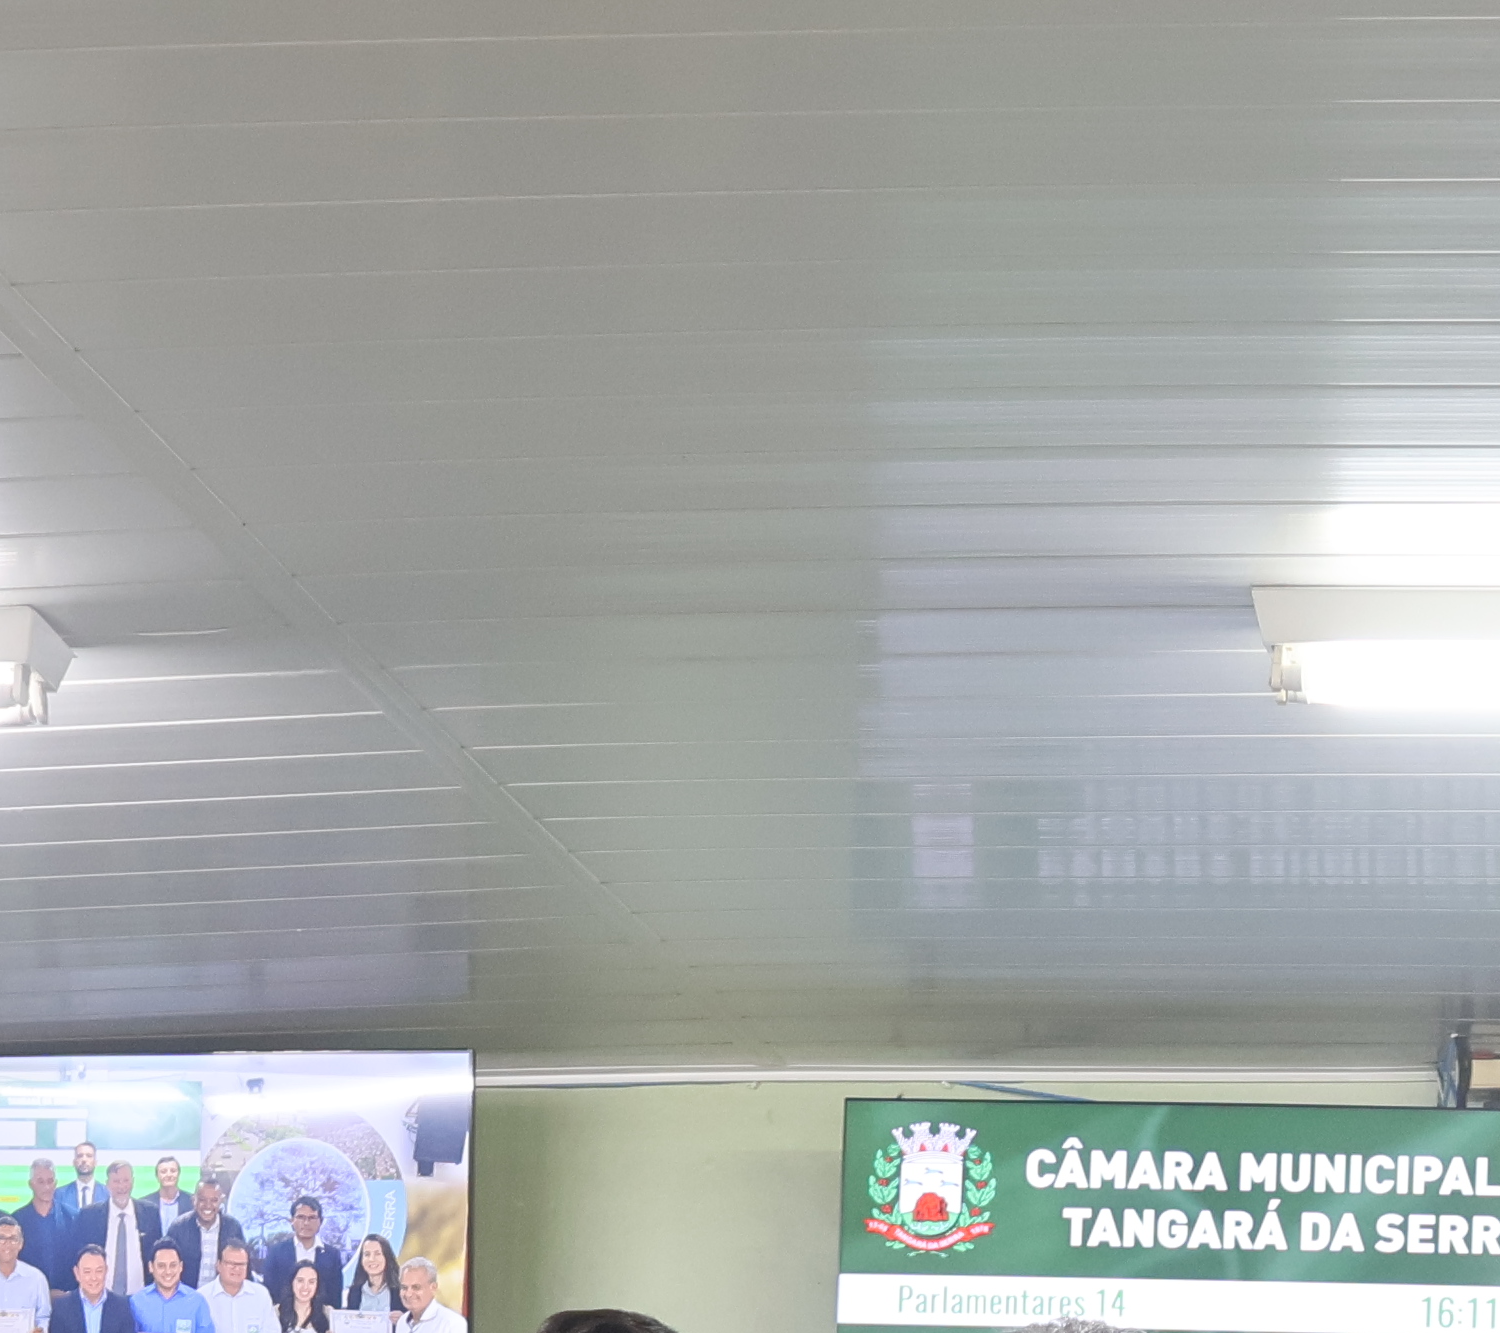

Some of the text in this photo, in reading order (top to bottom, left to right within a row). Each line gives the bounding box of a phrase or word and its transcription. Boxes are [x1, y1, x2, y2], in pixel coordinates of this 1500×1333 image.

[1026, 1137, 1227, 1191] CÂMARA
[1062, 1198, 1288, 1251] TANGARÁ
[1300, 1211, 1364, 1252] DA
[898, 1285, 1126, 1317] Parlamentares 14
